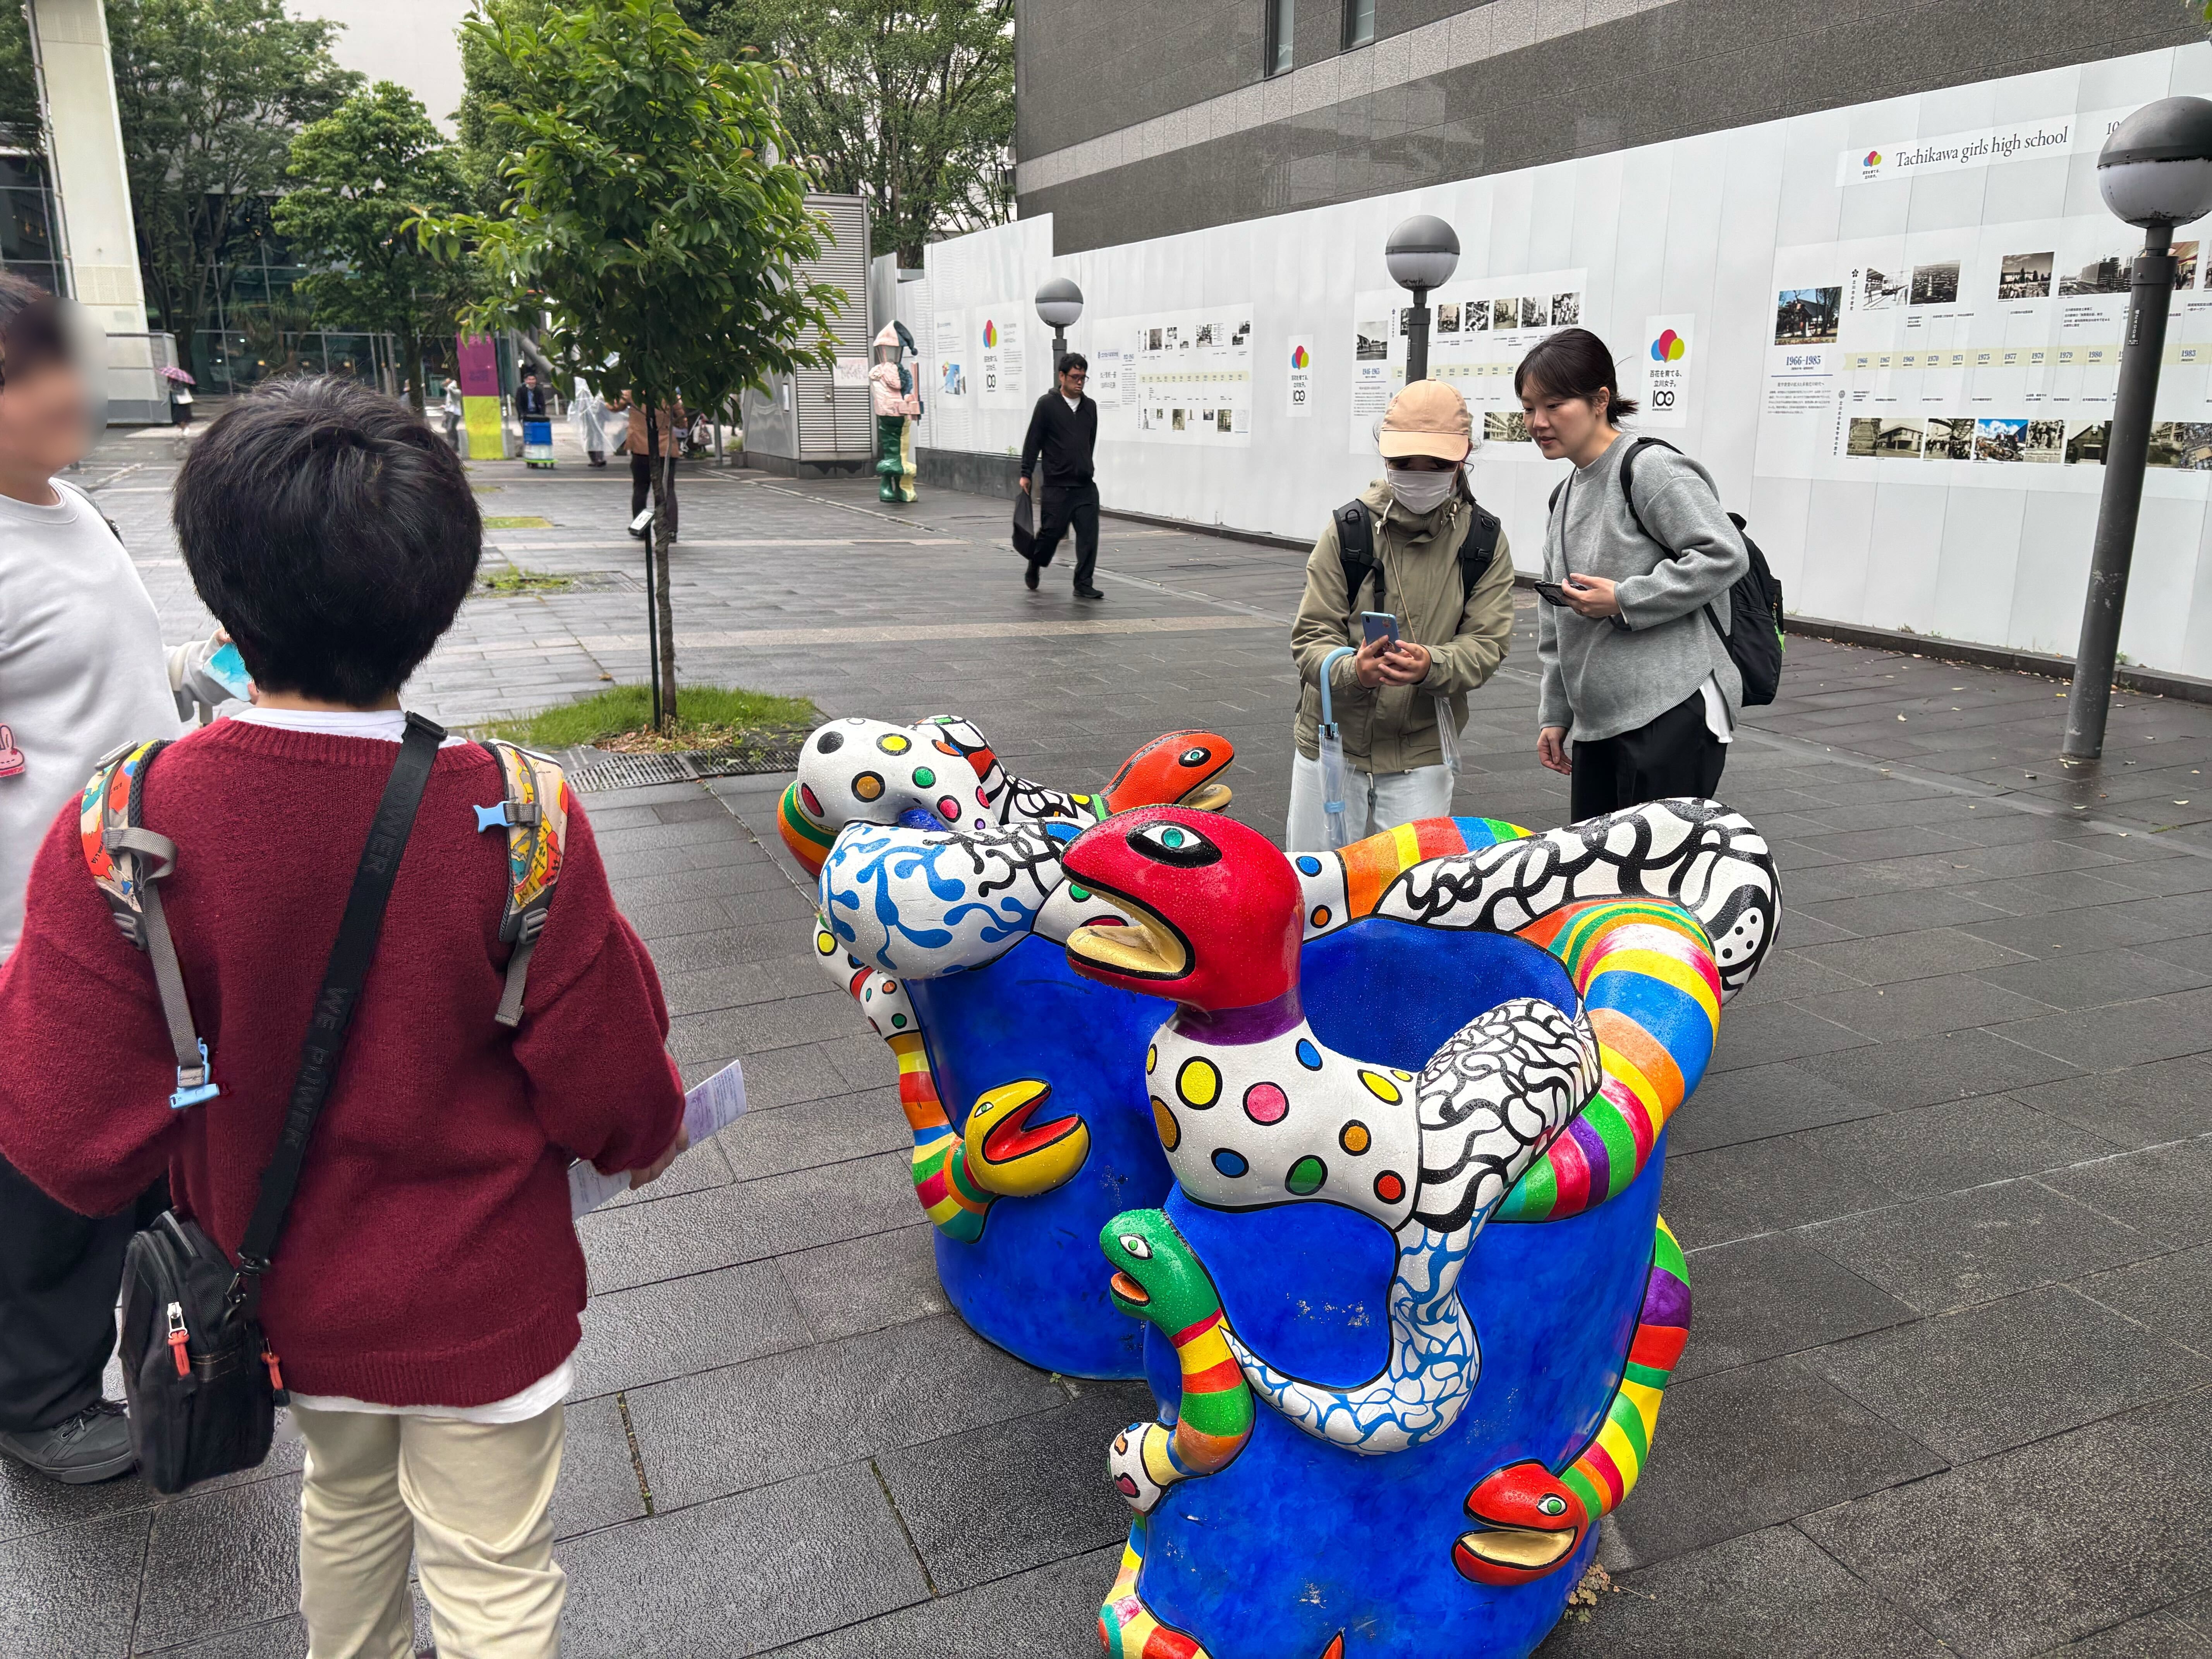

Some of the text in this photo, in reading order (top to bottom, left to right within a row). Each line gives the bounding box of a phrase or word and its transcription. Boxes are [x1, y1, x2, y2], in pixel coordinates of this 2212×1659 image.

[1896, 146, 1958, 167] Tachikawa
[1960, 138, 1989, 163] girls
[1991, 133, 2021, 157] high
[2024, 125, 2068, 148] school
[1786, 355, 1821, 366] 1966-1985
[1652, 390, 1675, 407] 100
